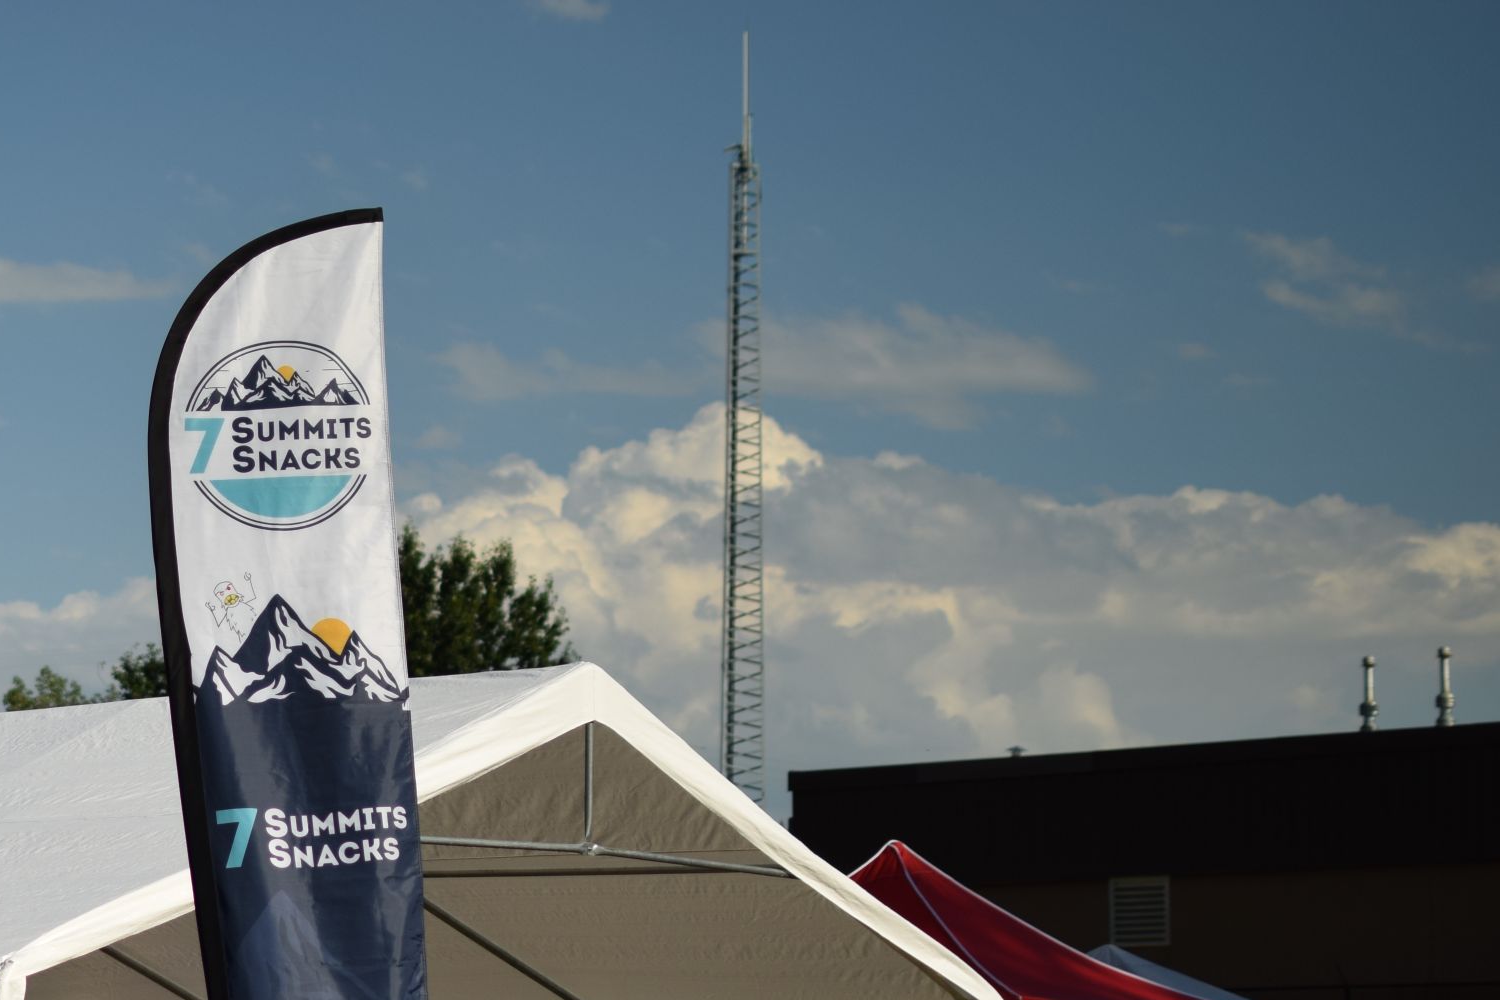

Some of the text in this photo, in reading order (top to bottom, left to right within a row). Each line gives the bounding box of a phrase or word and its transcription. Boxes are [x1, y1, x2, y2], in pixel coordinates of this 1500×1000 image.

[184, 416, 372, 474] 7 SUMMITS
[232, 445, 361, 473] SNACKS
[216, 806, 408, 869] 7 SUMMITS
[268, 837, 400, 869] SNACKS
